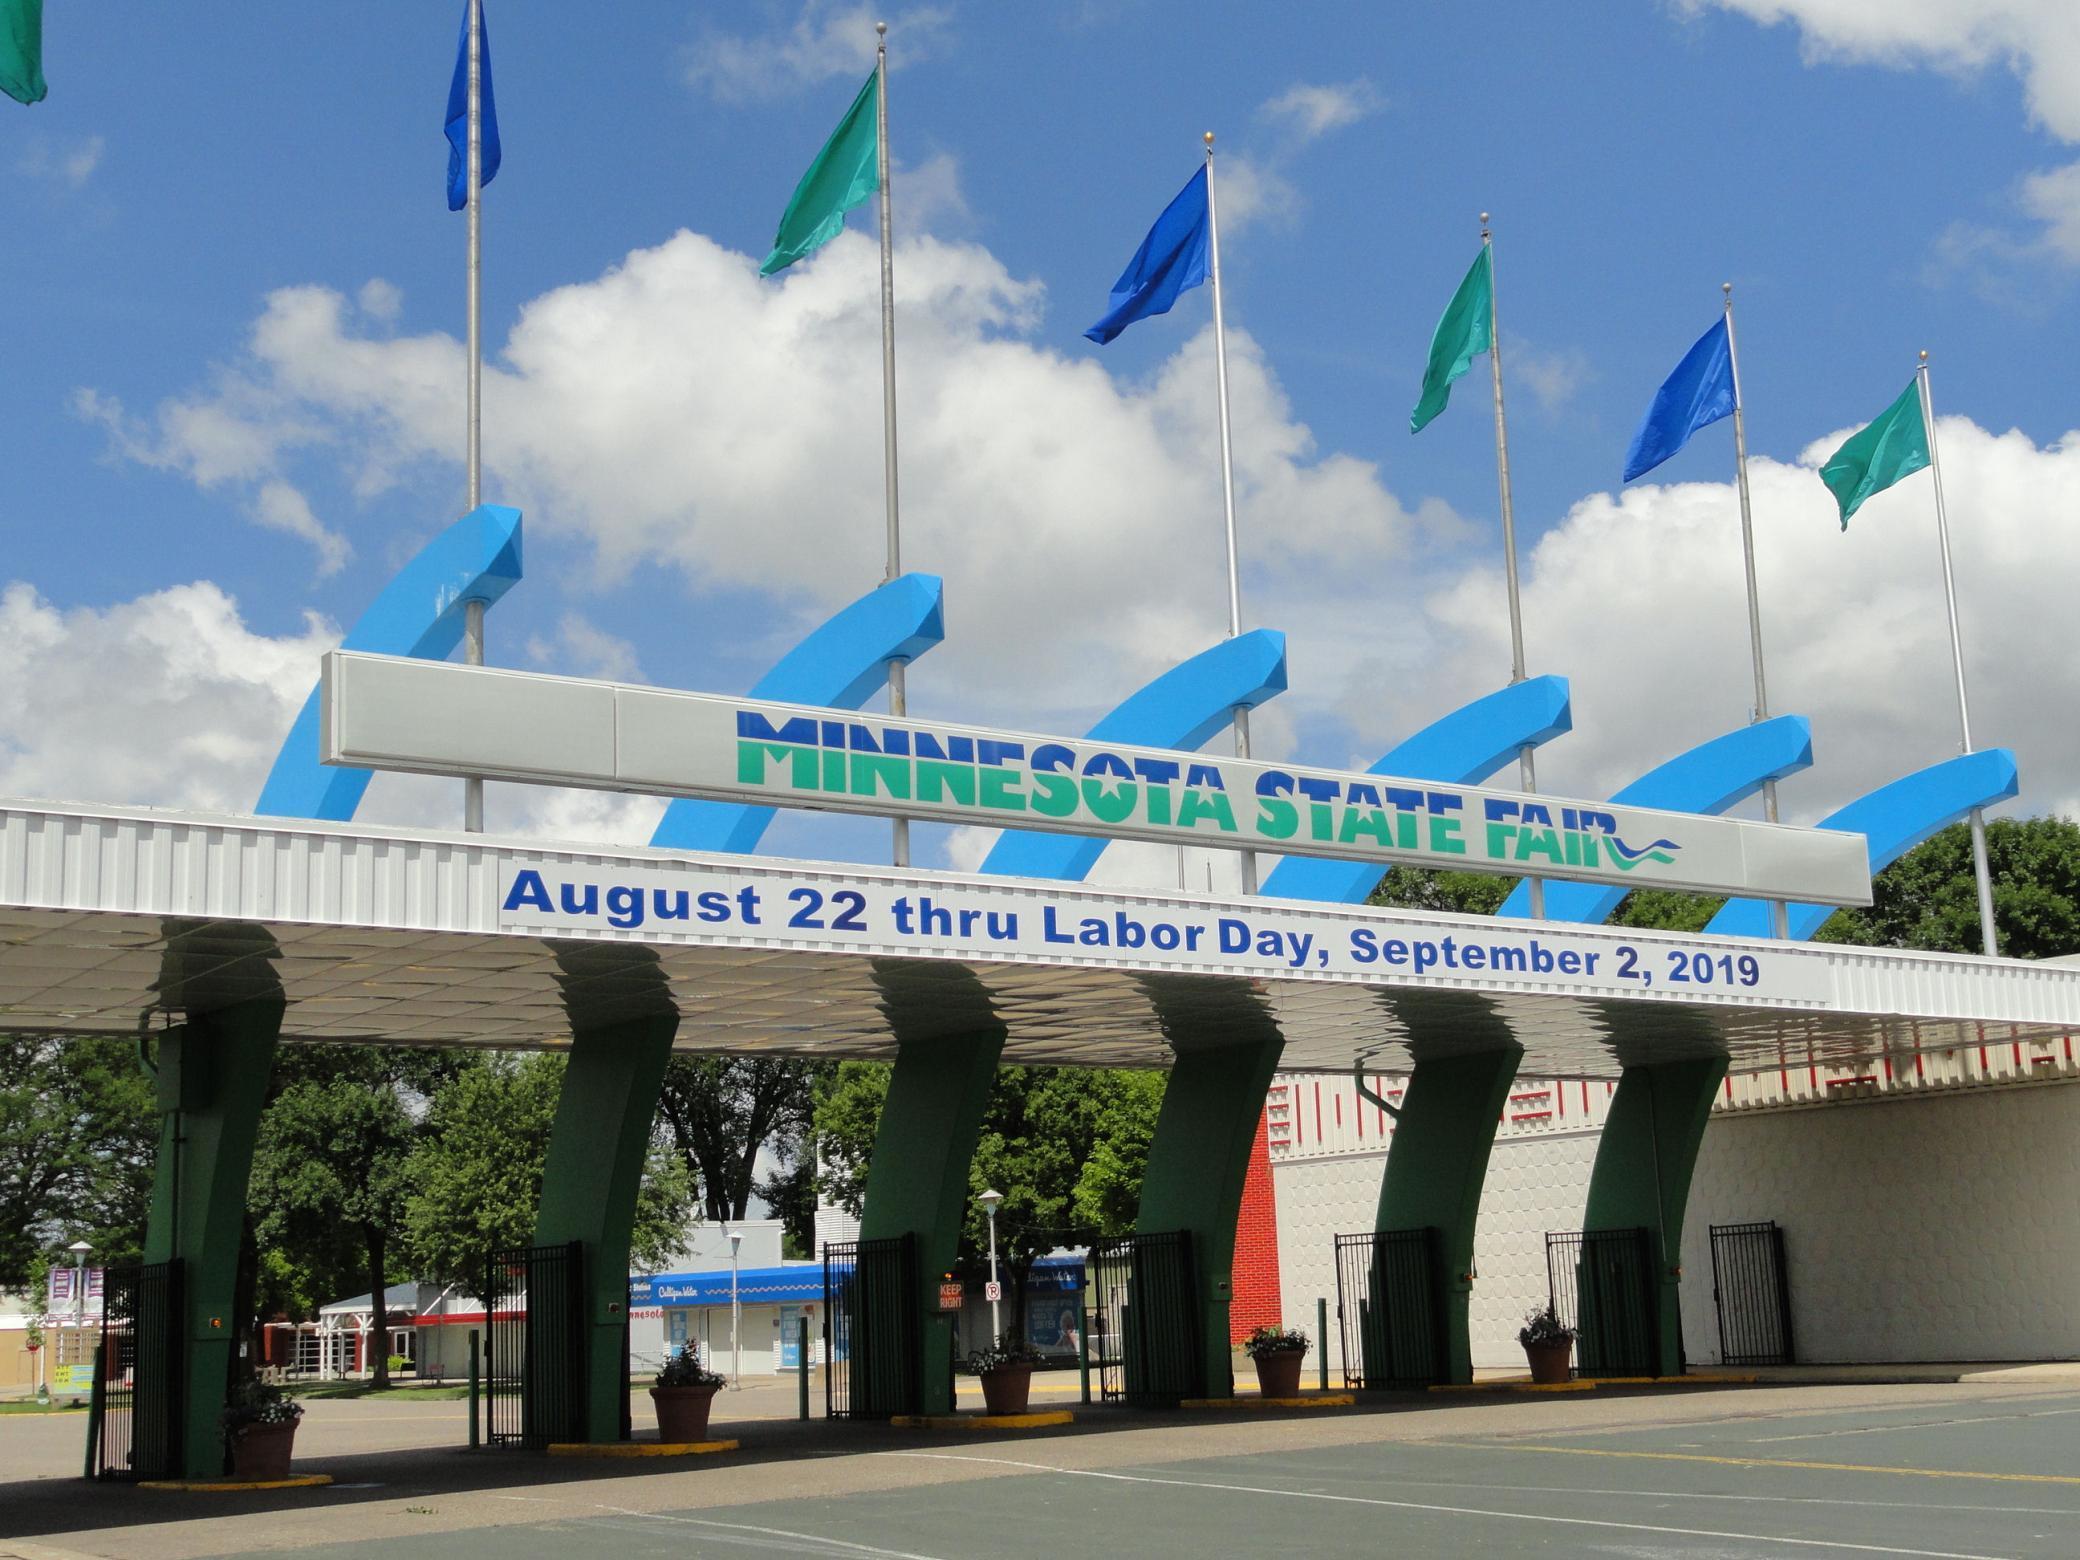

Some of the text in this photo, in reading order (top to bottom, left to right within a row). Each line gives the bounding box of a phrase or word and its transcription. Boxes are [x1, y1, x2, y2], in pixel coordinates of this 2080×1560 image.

[737, 710, 1682, 871] MINNESOTA STATE FAIR
[502, 869, 1760, 987] August 22 thru Labor Day, September 2, 2019
[658, 1285, 698, 1302] Culligan Water
[940, 1283, 962, 1296] KEEP
[940, 1297, 962, 1309] RIGHT
